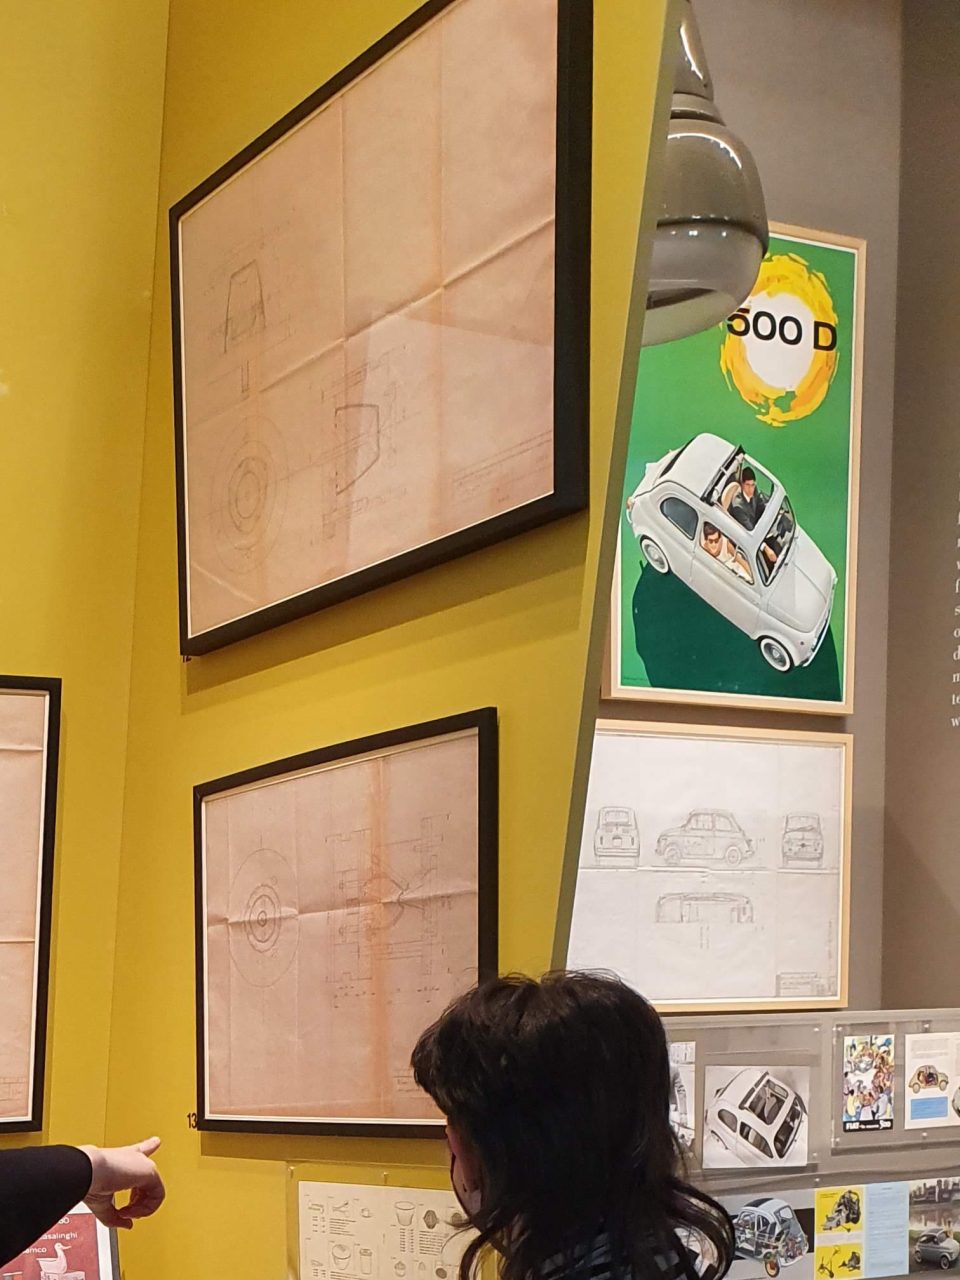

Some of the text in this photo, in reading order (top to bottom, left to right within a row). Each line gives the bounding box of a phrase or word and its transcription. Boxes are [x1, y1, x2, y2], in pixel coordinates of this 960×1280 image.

[726, 307, 838, 351] 500 D
[186, 1112, 197, 1129] 13
